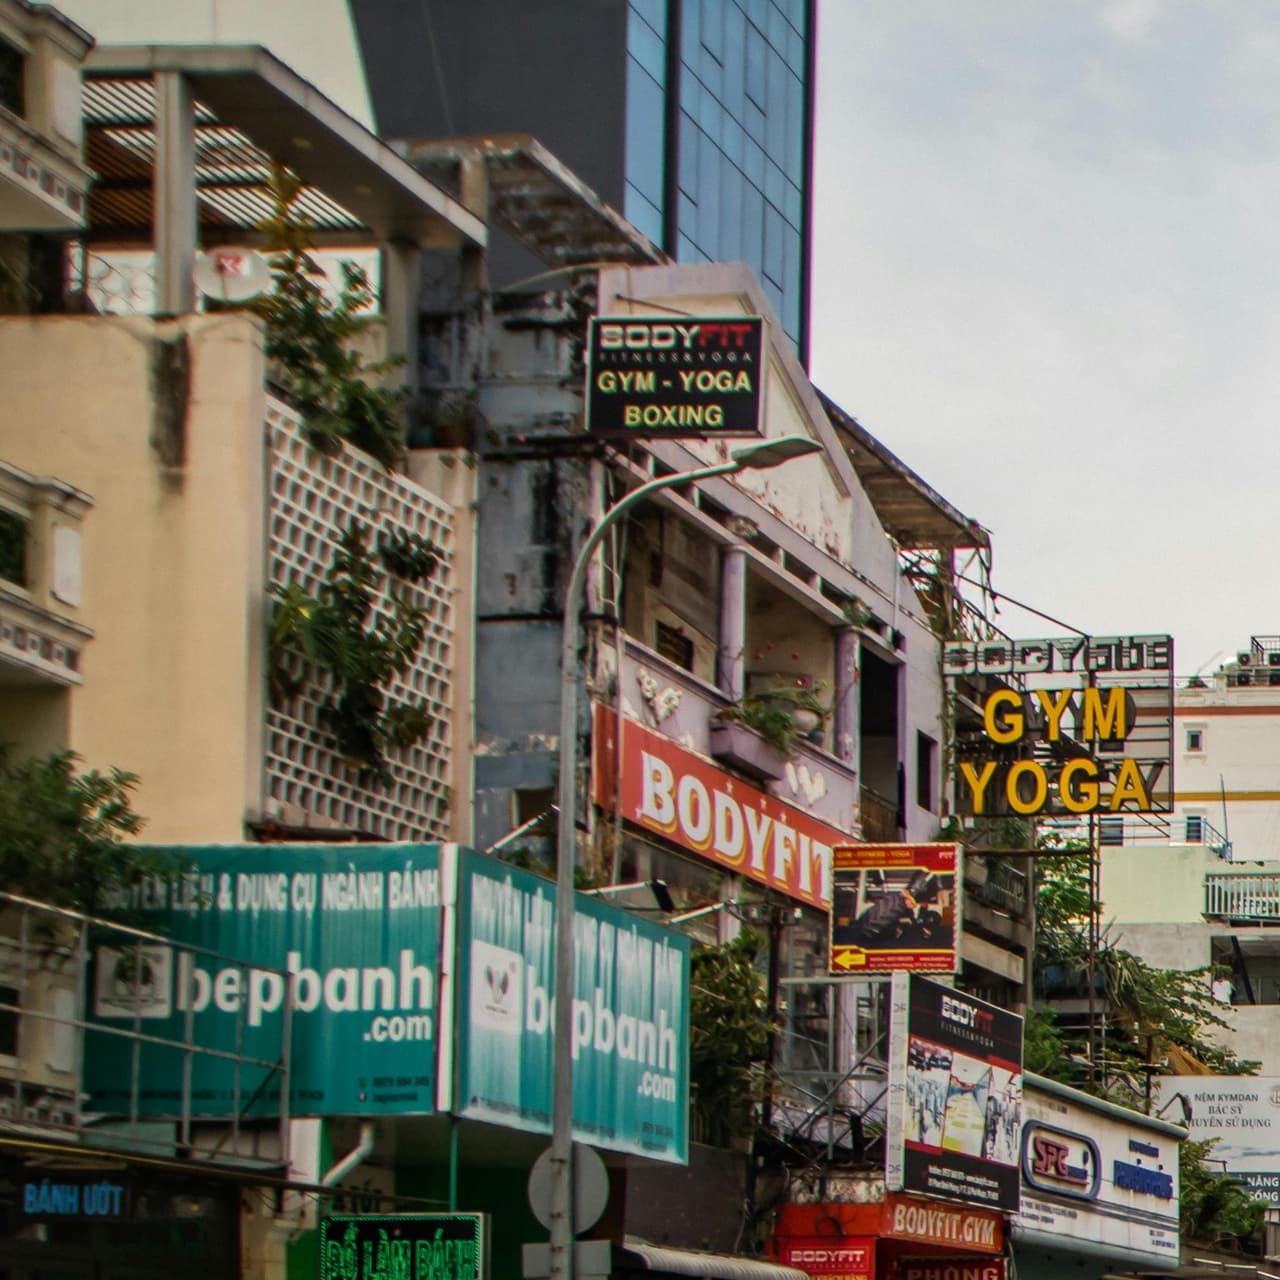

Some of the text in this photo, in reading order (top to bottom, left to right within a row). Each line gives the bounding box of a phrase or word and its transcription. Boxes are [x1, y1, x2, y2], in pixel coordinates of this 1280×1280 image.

[600, 324, 752, 348] BODYFIT
[598, 370, 656, 393] GYM
[679, 370, 752, 393] YOGA
[624, 404, 724, 427] BOXING
[984, 686, 1126, 744] GYM
[959, 757, 1150, 815] YOGA
[217, 873, 233, 911] &
[389, 859, 440, 907] BÁNH
[175, 948, 435, 1027] bepbanh
[363, 1015, 432, 1041] .com
[636, 1070, 677, 1103] .com
[24, 1178, 79, 1215] BÁNH
[791, 1250, 865, 1263] BODYFIT
